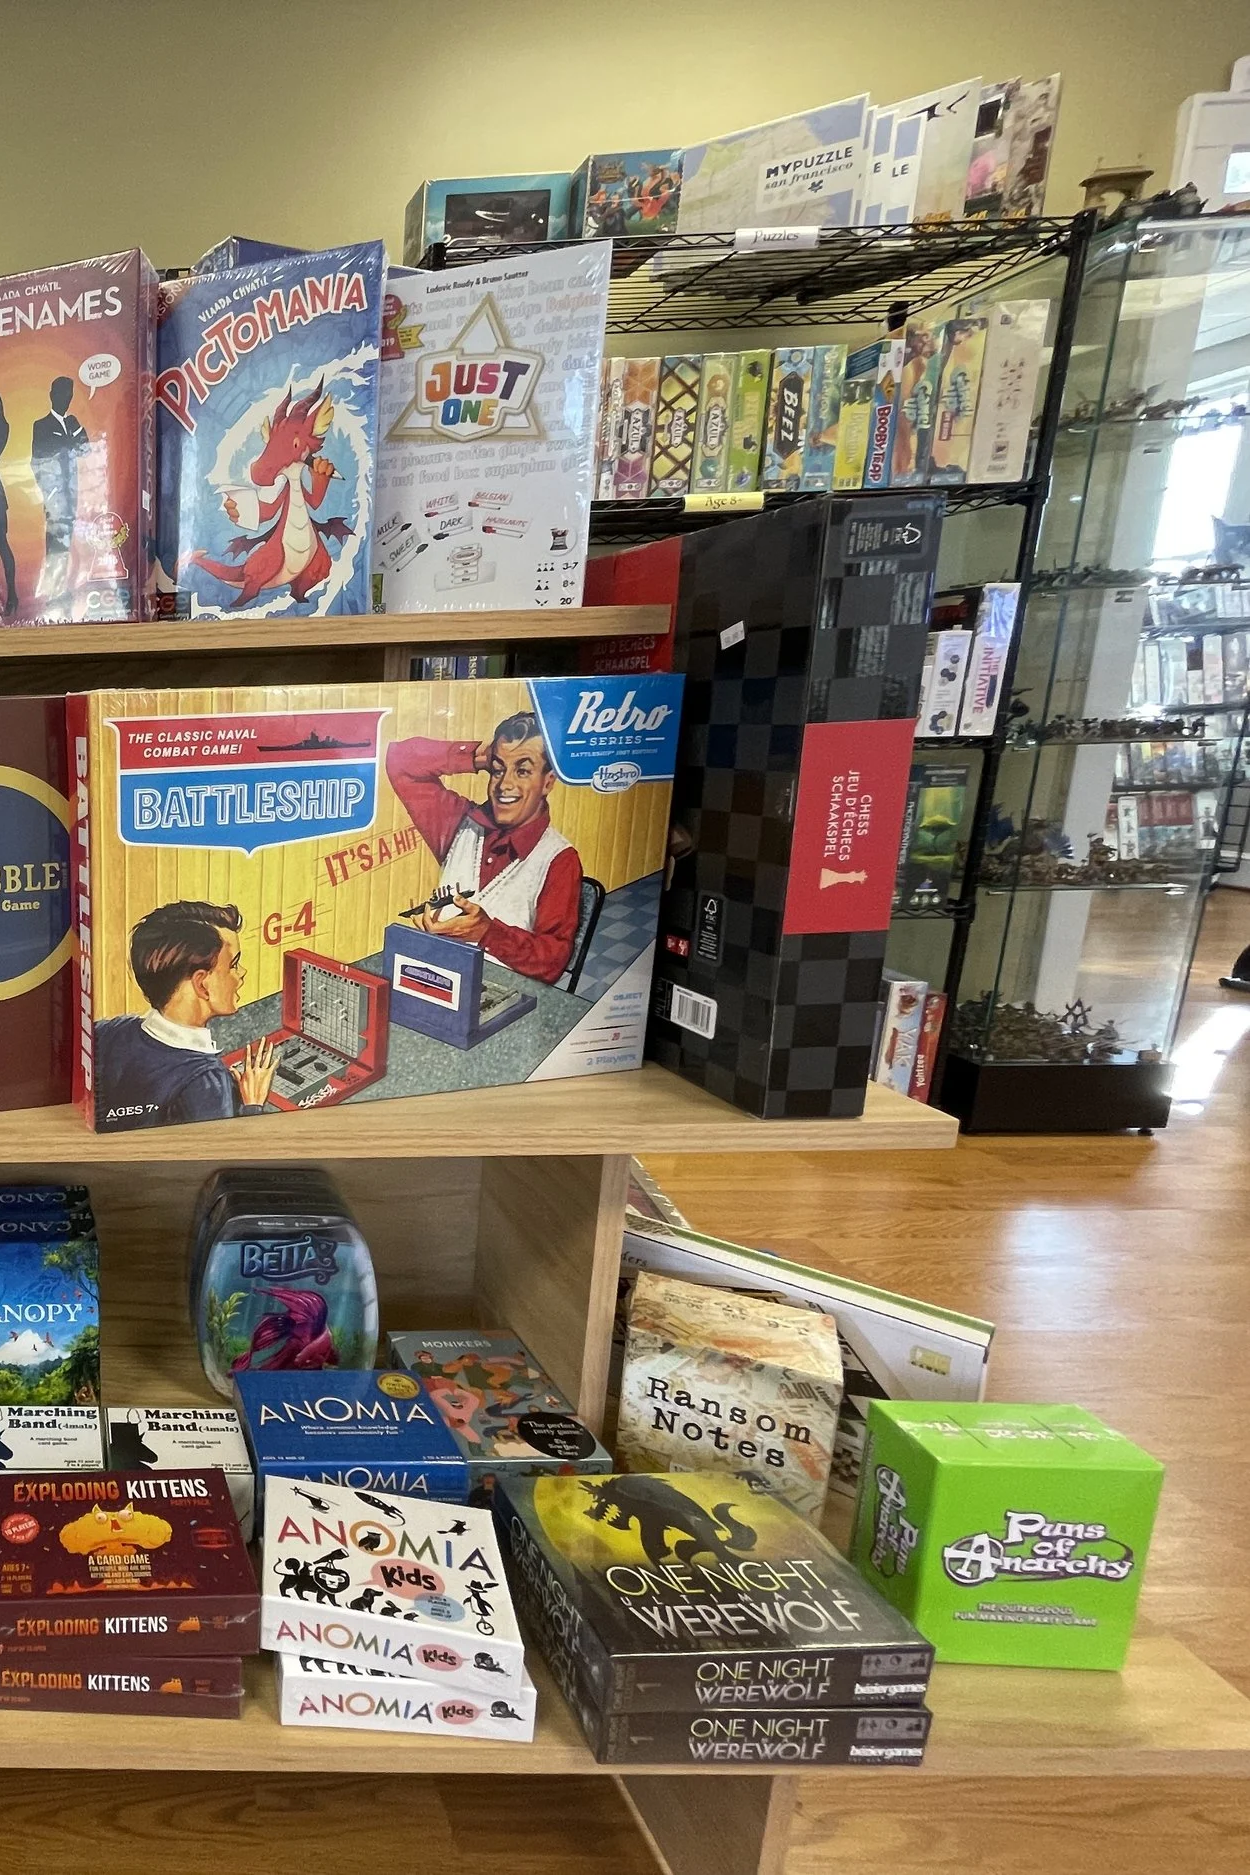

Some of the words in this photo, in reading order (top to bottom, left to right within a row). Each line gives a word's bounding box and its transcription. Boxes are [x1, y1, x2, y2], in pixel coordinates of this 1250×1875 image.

[765, 145, 853, 179] MYPUZZLE
[752, 229, 799, 246] Puzzles
[86, 359, 112, 372] WORD
[156, 271, 368, 436] PICTOMANIA
[425, 360, 531, 403] JUST
[440, 397, 499, 426] ONE
[630, 414, 643, 449] AZUL
[672, 412, 684, 444] AZUL
[708, 409, 723, 449] AZUL
[873, 403, 893, 453] BOOBY
[867, 449, 888, 484] TRAP
[704, 496, 721, 508] Age
[375, 516, 400, 538] MILK
[440, 516, 463, 530] DARK
[972, 646, 995, 715] INITIATIVE
[566, 690, 673, 735] Retro
[128, 732, 153, 744] THE
[157, 730, 213, 743] CLASSIC
[217, 728, 258, 740] NAVAL
[143, 745, 197, 758] COMBAT
[201, 743, 243, 756] GAME!
[589, 735, 642, 746] SERIES
[846, 769, 860, 794] JEU
[133, 778, 365, 830] BATTLESHIP
[823, 775, 844, 859] SCHAAKSPEL
[855, 794, 872, 836] CHESS
[838, 796, 857, 863] D'ÉCHECS
[325, 842, 374, 887] IT'S
[376, 838, 393, 864] A
[1, 898, 41, 913] Game
[74, 734, 94, 1092] BATTLESHIP
[262, 900, 317, 946] G-4
[106, 1103, 145, 1118] AGES
[146, 1102, 160, 1114] 7+
[242, 1240, 318, 1274] BETTA
[422, 1340, 492, 1350] MONIKERS
[7, 1406, 98, 1419] Marching
[145, 1409, 238, 1422] Marching
[259, 1396, 435, 1426] ANOMIA
[647, 1376, 812, 1445] Ransom
[652, 1406, 785, 1468] Notes
[13, 1480, 120, 1503] EXPLODING
[125, 1478, 209, 1500] KITTENS
[1002, 1510, 1106, 1544] Puns
[88, 1555, 95, 1565] A
[96, 1554, 122, 1565] CARD
[123, 1553, 150, 1565] GAME
[277, 1515, 496, 1581] ANOMIA
[942, 1532, 1134, 1586] Anarchy
[1031, 1538, 1076, 1558] of
[379, 1564, 437, 1591] Kids
[607, 1563, 700, 1598] ONE
[702, 1560, 828, 1595] NIGHT
[628, 1599, 863, 1639] WEREWOLF
[953, 1611, 976, 1621] PUN
[979, 1613, 1024, 1624] MAKING
[1028, 1615, 1061, 1625] PARTY
[1062, 1617, 1098, 1627] GAME
[978, 1602, 997, 1611] THE
[999, 1604, 1074, 1615] OUTRAGEOUS
[16, 1618, 100, 1637] EXPLODING
[104, 1616, 168, 1634] KITTENS
[276, 1620, 414, 1666] ANOMIA
[422, 1650, 457, 1666] Kids
[1, 1669, 82, 1690] EXPLODING
[87, 1674, 150, 1692] KITTENS
[695, 1660, 752, 1682] ONE
[758, 1657, 835, 1680] NIGHT
[298, 1692, 433, 1724] ANOMIA
[441, 1703, 475, 1720] Kids
[695, 1682, 830, 1705] WEREWOLF
[689, 1719, 747, 1739] ONE
[752, 1717, 830, 1738] NIGHT
[688, 1742, 827, 1762] WEREWOLF
